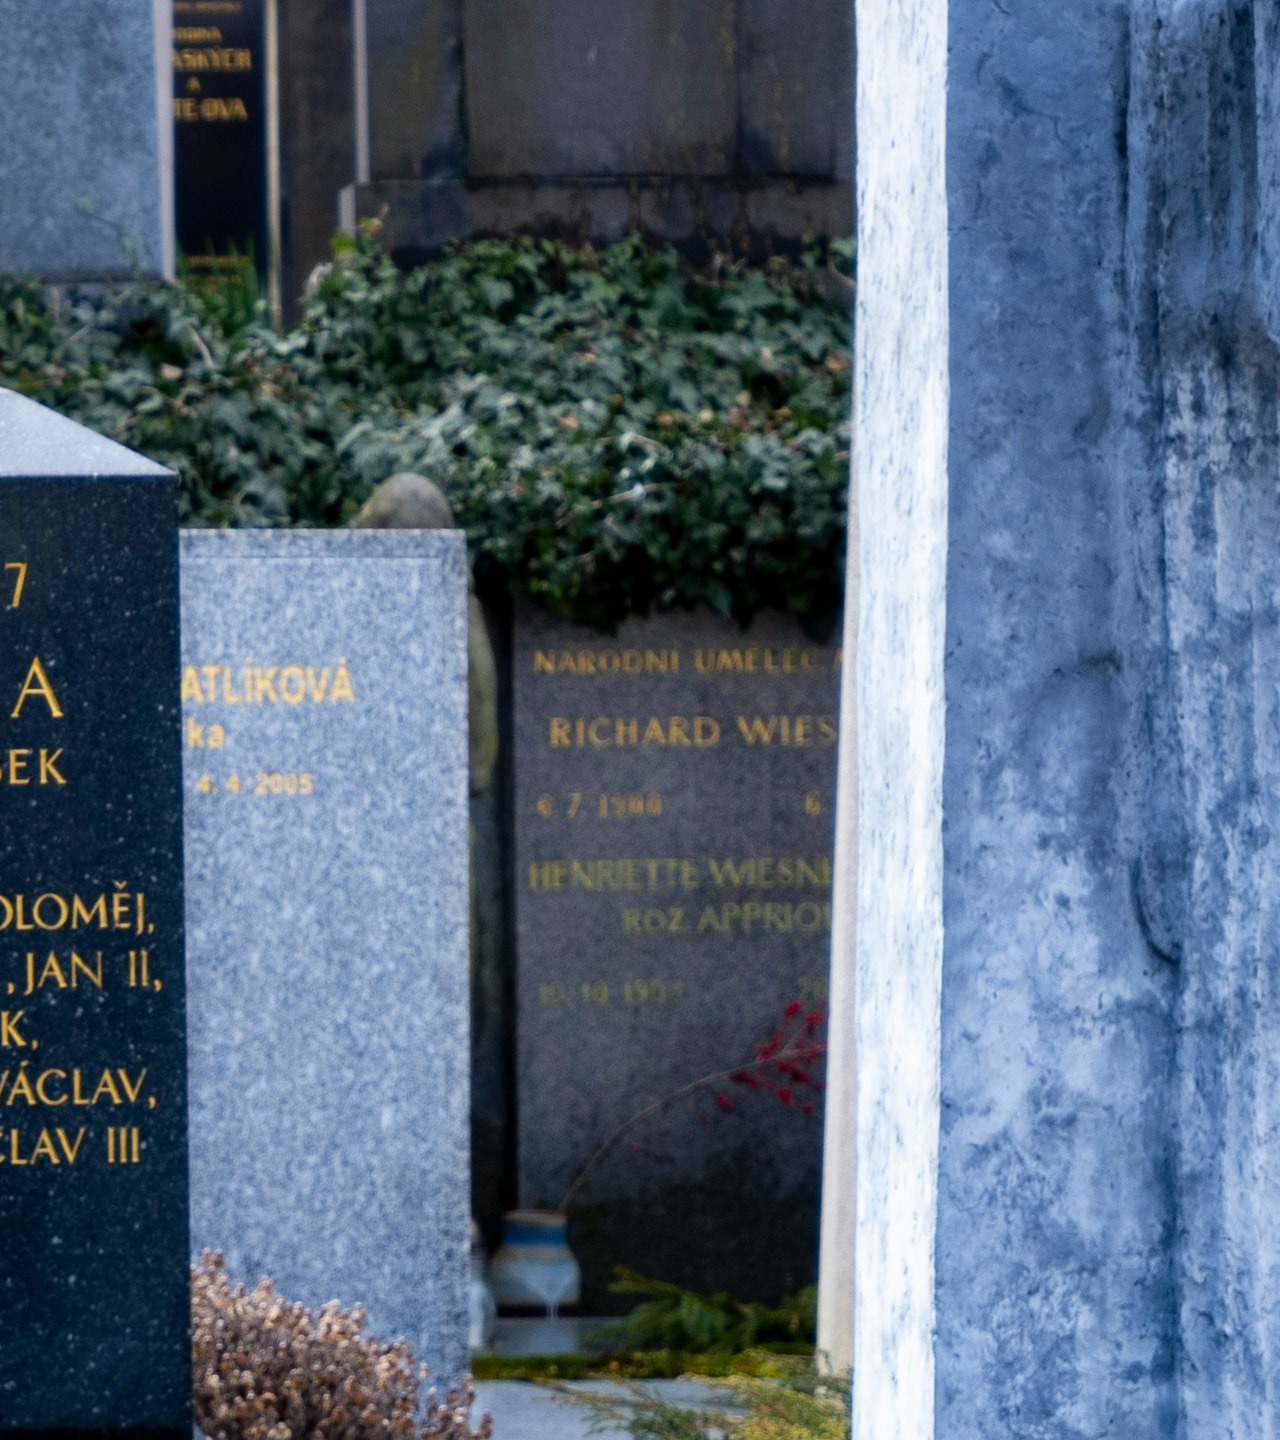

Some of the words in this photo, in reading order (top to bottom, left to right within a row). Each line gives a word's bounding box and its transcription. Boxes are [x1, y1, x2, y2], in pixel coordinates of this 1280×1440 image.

[548, 716, 721, 748] RICHARD
[25, 951, 103, 995] JAN
[107, 1126, 142, 1165] III
